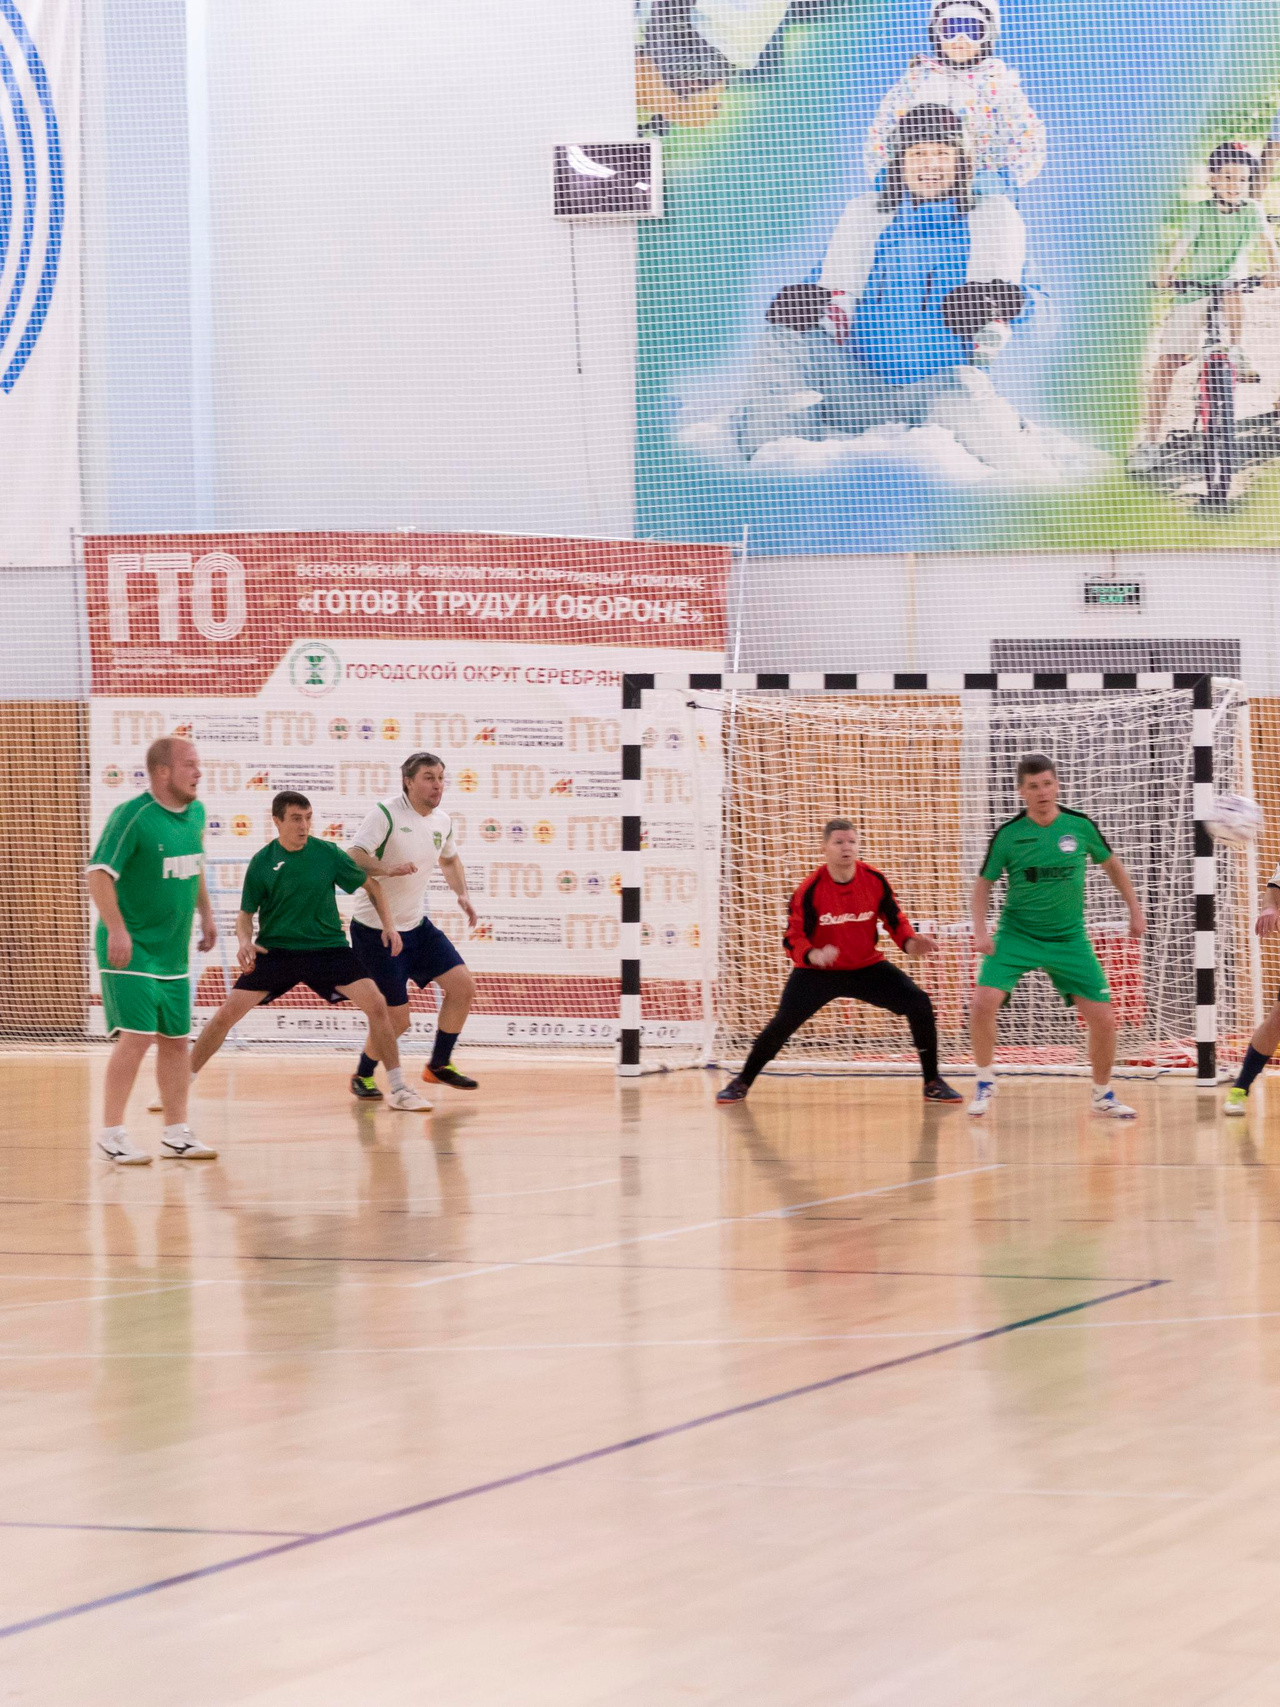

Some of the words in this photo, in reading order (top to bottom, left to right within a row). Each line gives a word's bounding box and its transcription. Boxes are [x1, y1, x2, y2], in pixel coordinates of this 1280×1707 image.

[107, 552, 247, 641] ГТО
[297, 590, 399, 614] «ГОТОВ
[405, 591, 426, 615] К
[433, 591, 519, 620] ТРУДУ
[524, 595, 548, 618] И
[555, 595, 702, 624] ОБОРОНЕ»
[345, 662, 458, 683] ГОРОДСКОЙ
[463, 665, 521, 684] ОКРУГ
[524, 667, 625, 688] СЕРЕБРЯН
[265, 711, 316, 746] ГТО
[414, 713, 467, 748] ГТО
[569, 717, 621, 752] ГТО
[339, 761, 391, 795] ГТО
[492, 764, 544, 799] ГТО
[567, 816, 620, 851] ГТО
[490, 862, 543, 898] ГТО
[566, 914, 619, 950] ГТО
